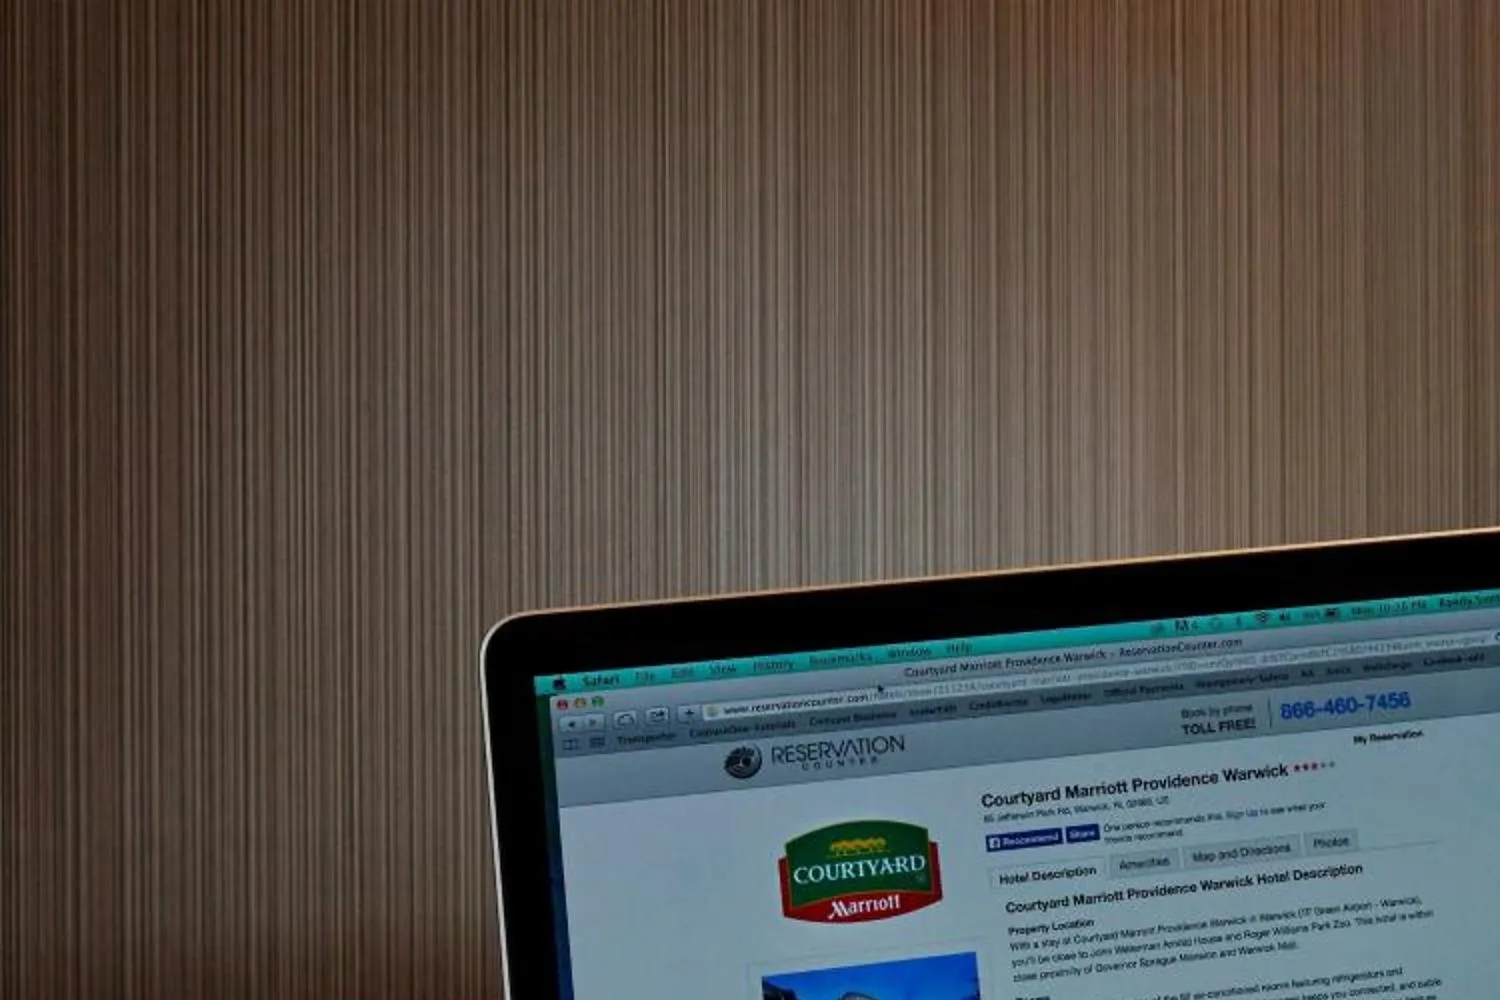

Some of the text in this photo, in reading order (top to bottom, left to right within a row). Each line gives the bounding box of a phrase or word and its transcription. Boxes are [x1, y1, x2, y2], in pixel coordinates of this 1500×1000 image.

[904, 636, 1242, 679] Courtyard Marriott Providence Warwick ReservationCounter.com
[583, 674, 620, 687] Safari
[752, 658, 793, 673] History
[1203, 705, 1219, 718] by
[1222, 702, 1253, 716] phone
[1280, 690, 1411, 720] 866-460-7456
[1181, 717, 1256, 736] TOLL FREE!
[1369, 728, 1423, 742] Reservation
[770, 733, 906, 764] RESERVATION
[801, 756, 879, 770] COUNTER
[980, 762, 1288, 810] Courtyard Marriott Providence Warwick
[1313, 835, 1349, 848] Photos
[1193, 842, 1290, 864] Map and Directions
[793, 854, 926, 884] COURTYARD
[999, 864, 1097, 885] Hotel Description
[1005, 862, 1363, 915] Courtyard Marriott Providence Warwick Hotel Description
[826, 894, 901, 918] Marriott
[1008, 918, 1094, 938] Property Location
[1073, 930, 1118, 945] Courtyard
[1157, 920, 1207, 934] Providence
[1210, 915, 1246, 928] Warwick
[1259, 909, 1295, 922] Warwick
[1311, 920, 1331, 931] Park
[1238, 942, 1275, 955] Warwick
